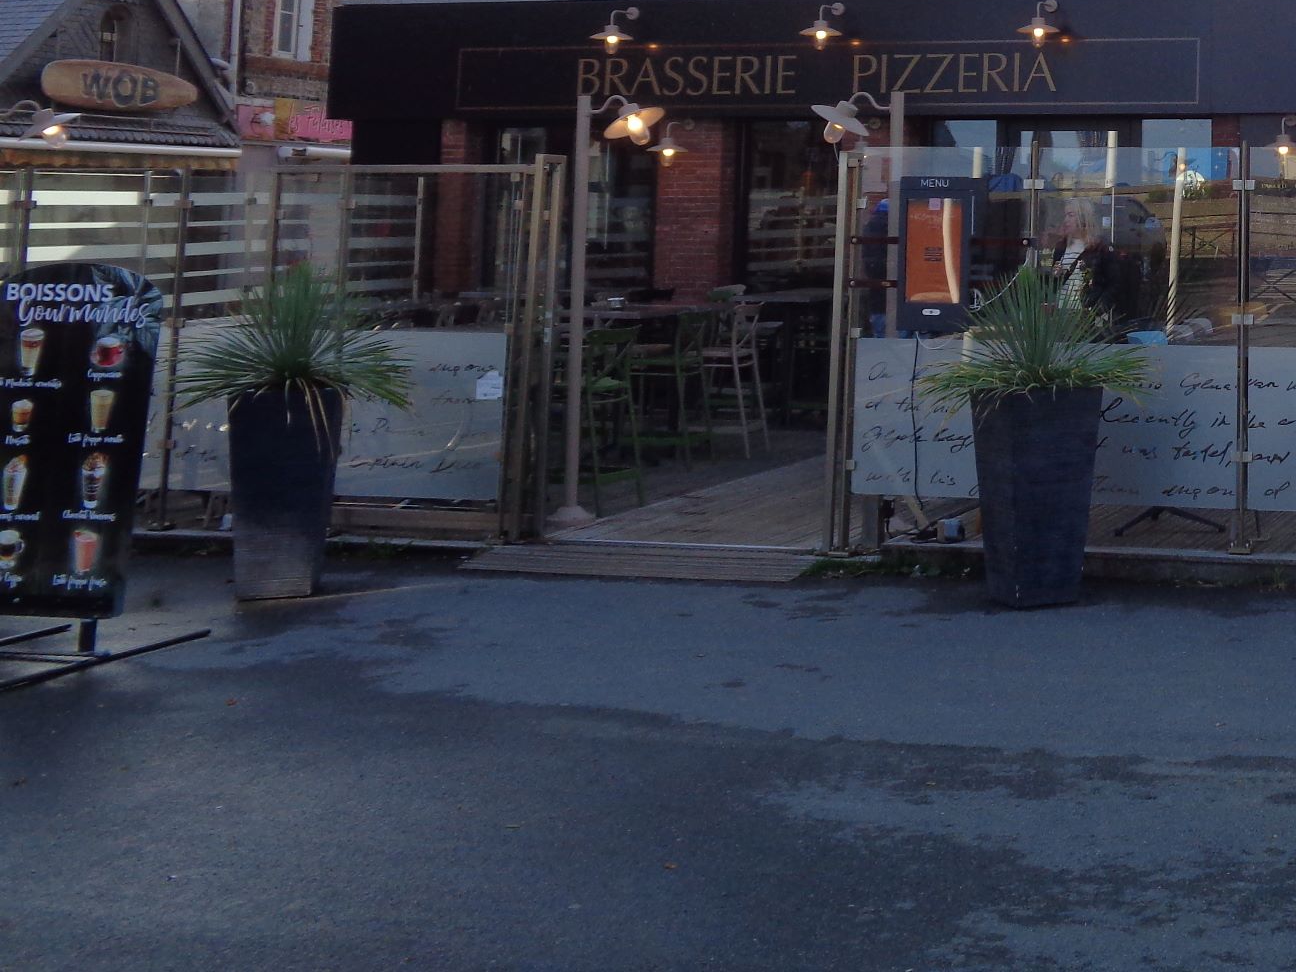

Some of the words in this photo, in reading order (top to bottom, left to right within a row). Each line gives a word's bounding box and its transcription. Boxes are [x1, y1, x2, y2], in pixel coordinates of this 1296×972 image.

[80, 68, 159, 107] WOB
[577, 54, 797, 96] BRASSERIE
[852, 51, 1057, 93] PIZZERIA
[920, 179, 949, 188] MENU
[6, 283, 115, 302] BOISSONS
[18, 296, 151, 328] Gourmandes
